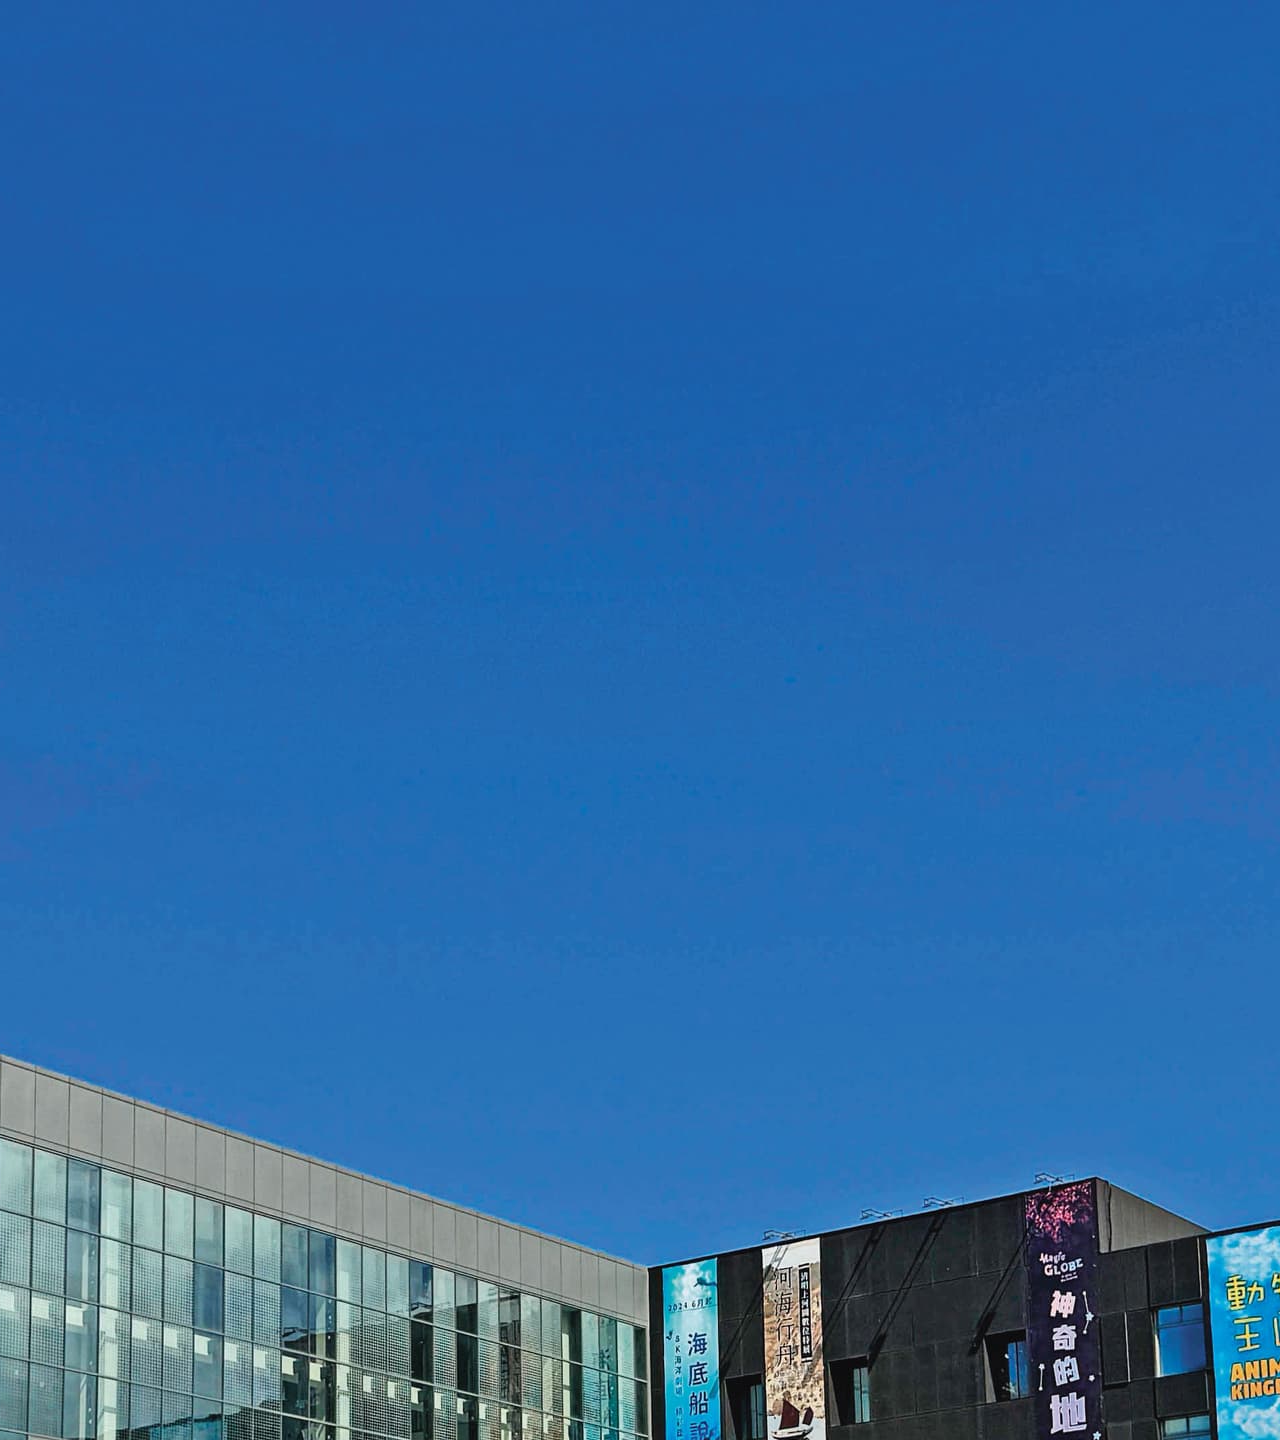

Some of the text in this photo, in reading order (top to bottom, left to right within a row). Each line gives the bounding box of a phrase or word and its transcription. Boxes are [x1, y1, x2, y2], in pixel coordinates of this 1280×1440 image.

[1044, 1258, 1084, 1277] GLOBE
[775, 1266, 796, 1366] 河海行舟
